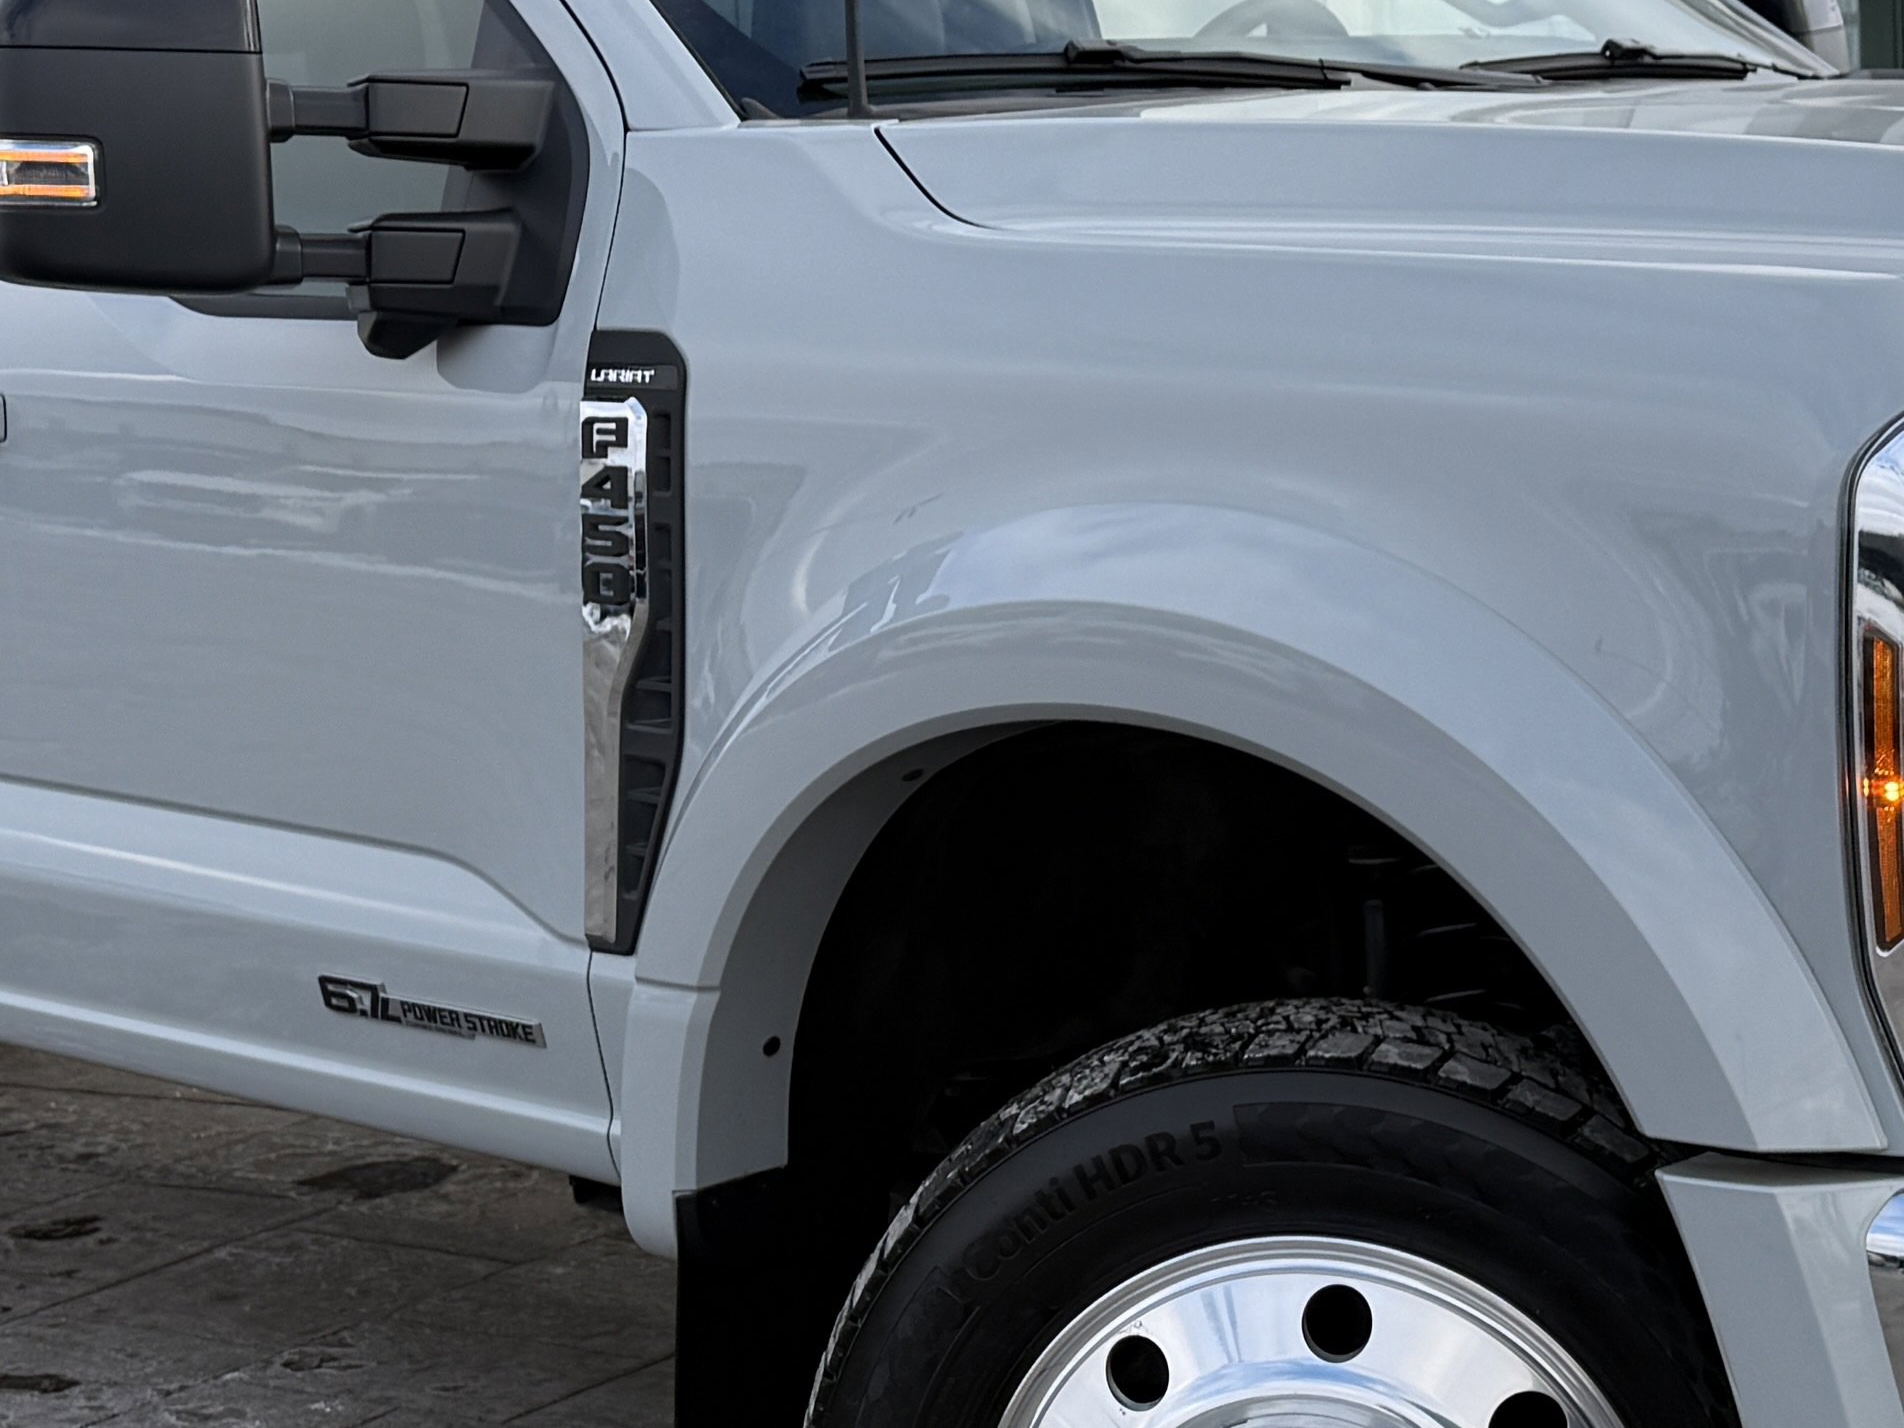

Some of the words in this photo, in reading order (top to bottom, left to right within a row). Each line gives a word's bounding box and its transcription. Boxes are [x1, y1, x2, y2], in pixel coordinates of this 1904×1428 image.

[590, 367, 655, 384] LARIAT
[317, 972, 401, 1025] 6.7L
[400, 1000, 462, 1029] POWER
[464, 1014, 536, 1043] STROKE
[963, 1176, 1076, 1281] Conti
[1076, 1133, 1183, 1201] HDR
[1190, 1120, 1222, 1160] 5
